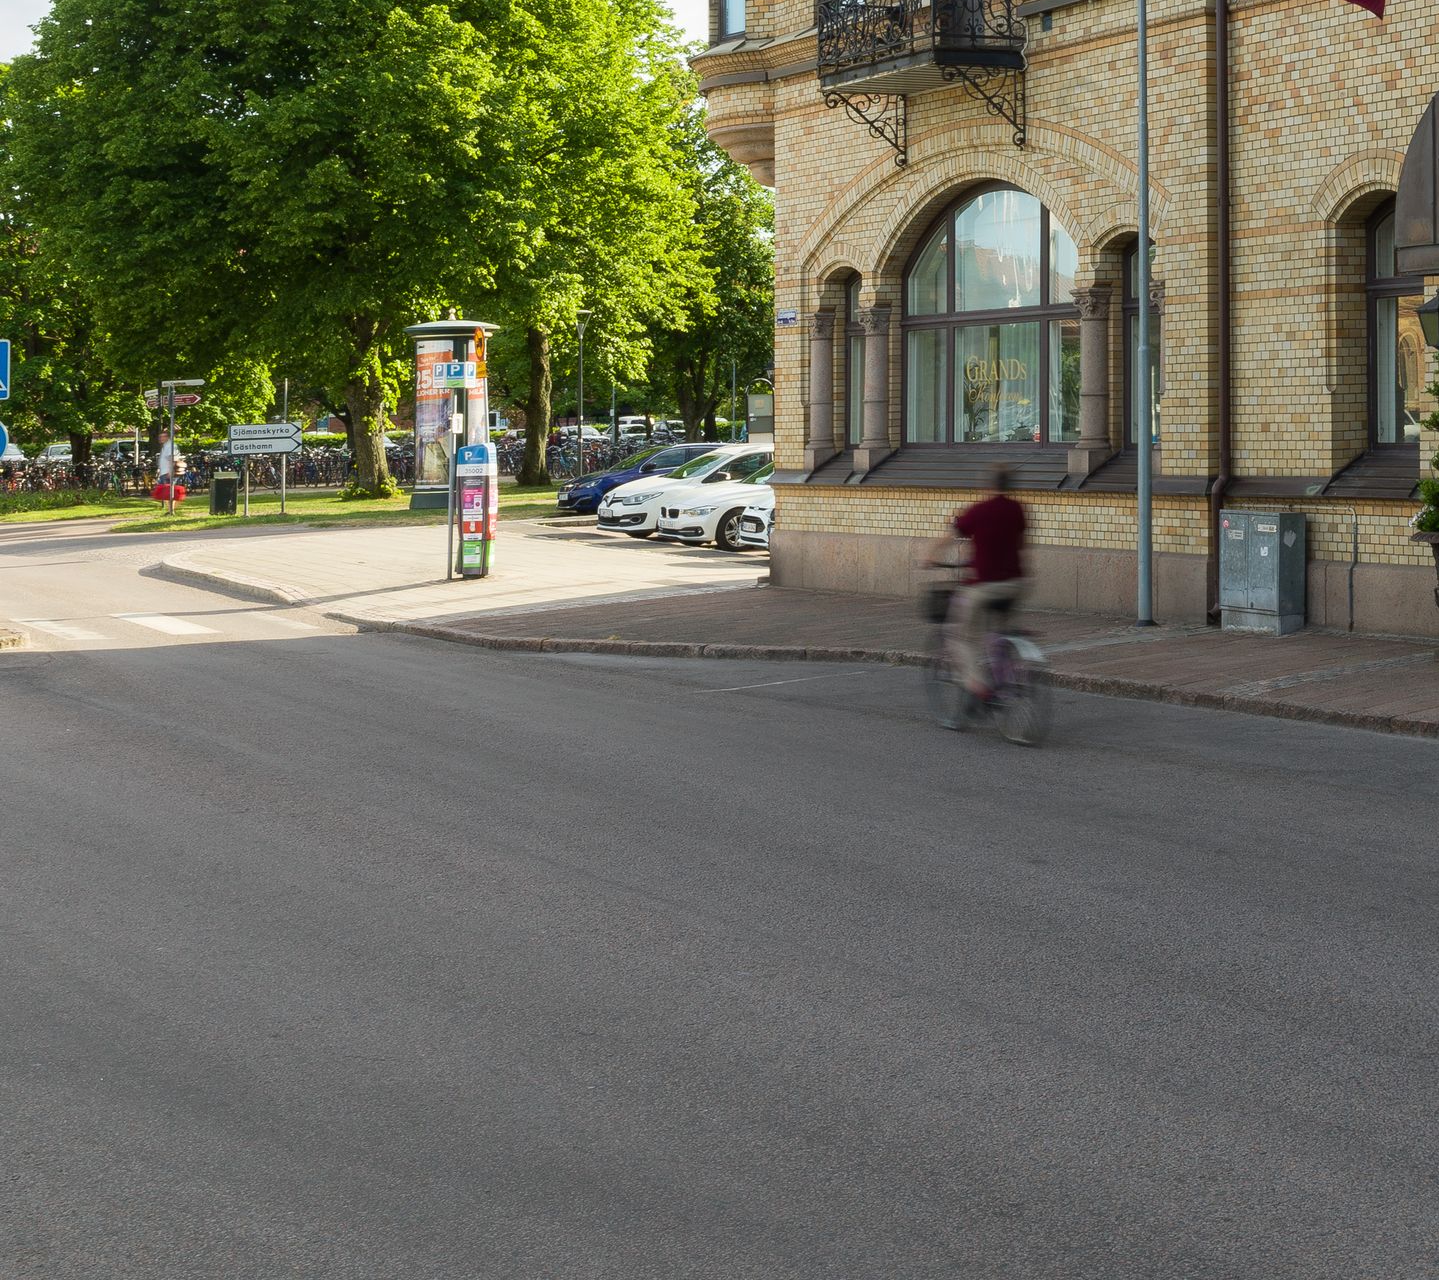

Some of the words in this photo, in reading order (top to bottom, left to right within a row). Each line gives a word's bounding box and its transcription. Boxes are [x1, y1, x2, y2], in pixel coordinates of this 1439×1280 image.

[450, 364, 460, 375] P
[233, 428, 290, 436] Sjömanskyrka
[464, 451, 472, 460] P
